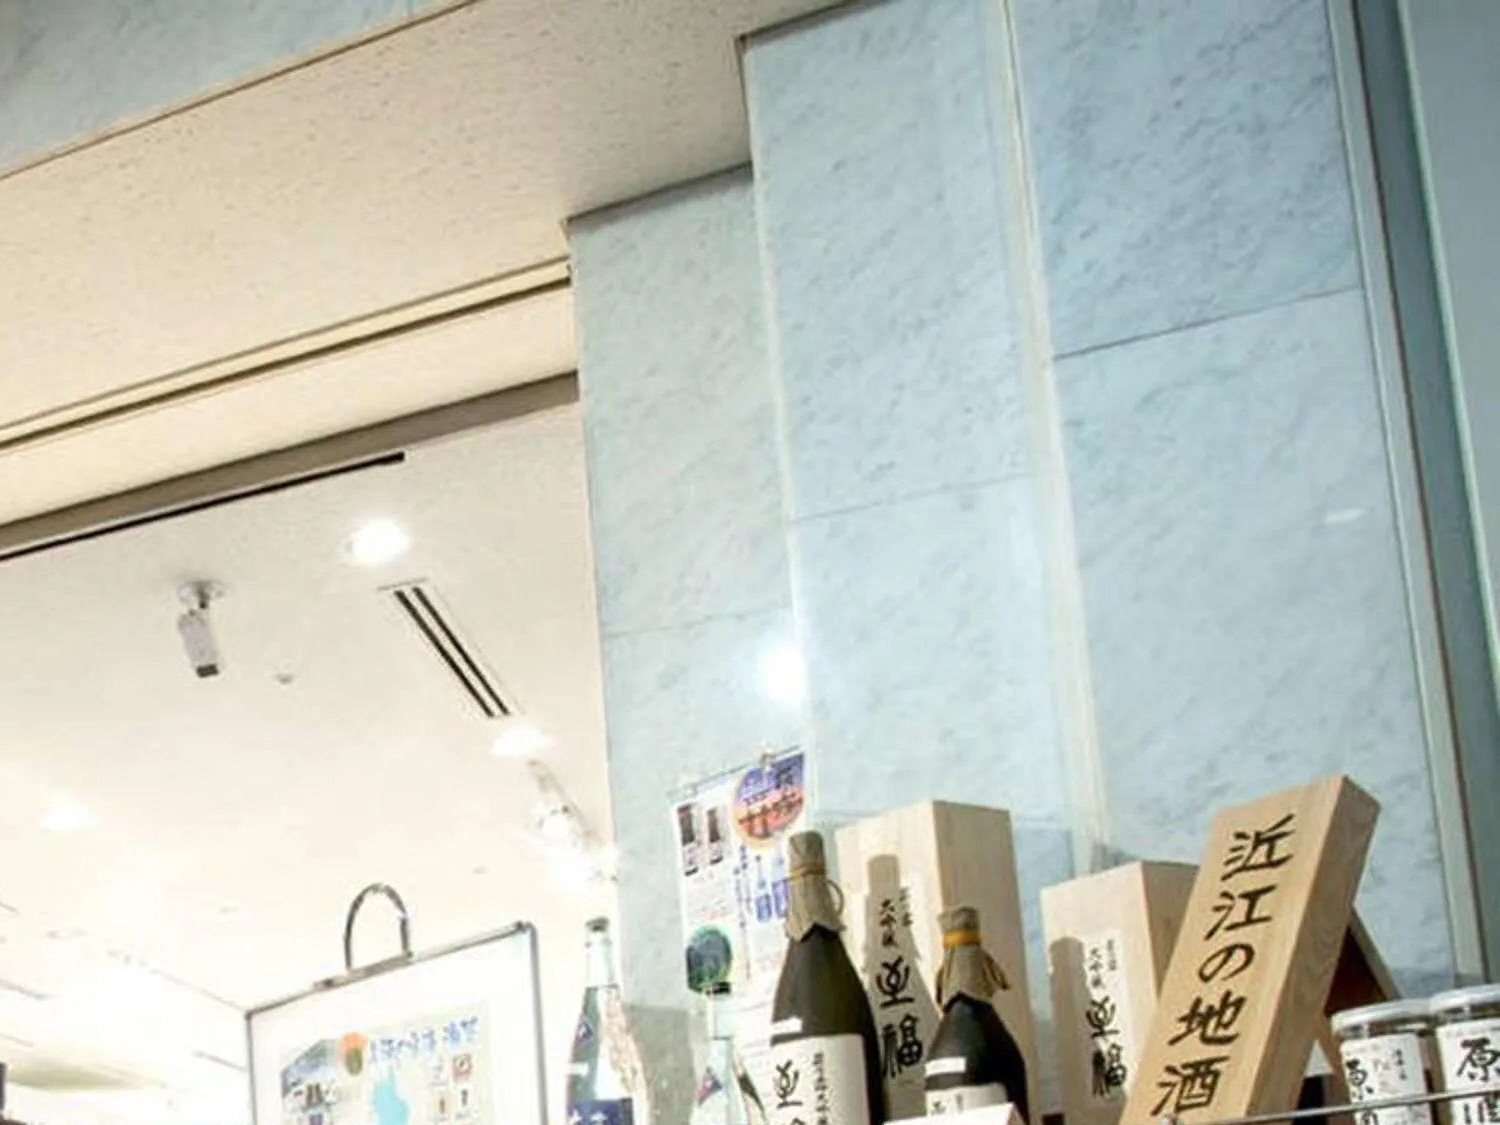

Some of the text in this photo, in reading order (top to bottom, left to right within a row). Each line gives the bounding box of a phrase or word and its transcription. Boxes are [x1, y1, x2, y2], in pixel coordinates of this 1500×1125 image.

[1149, 813, 1296, 1118] 近江の地酒
